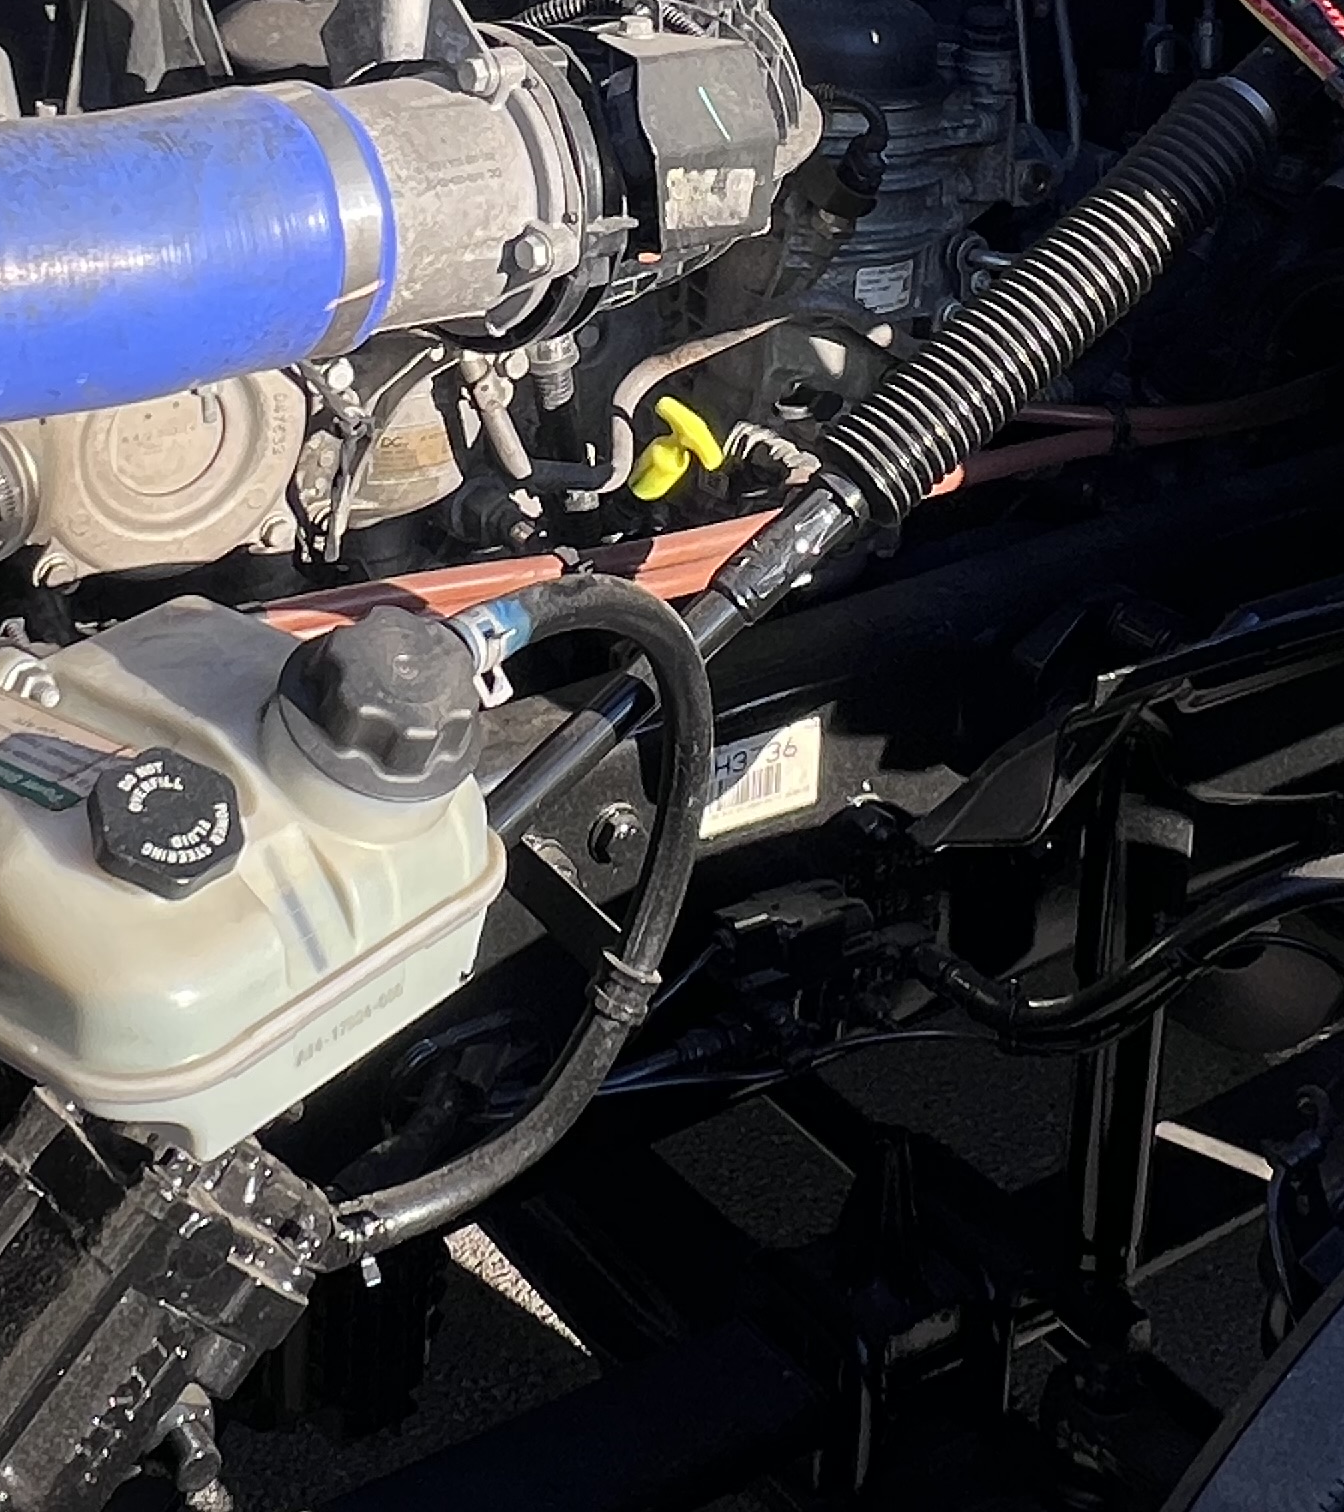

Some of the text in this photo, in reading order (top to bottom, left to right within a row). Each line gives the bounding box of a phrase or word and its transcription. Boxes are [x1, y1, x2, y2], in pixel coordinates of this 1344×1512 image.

[116, 761, 164, 792] DO NOT
[128, 774, 184, 812] OVERFILL
